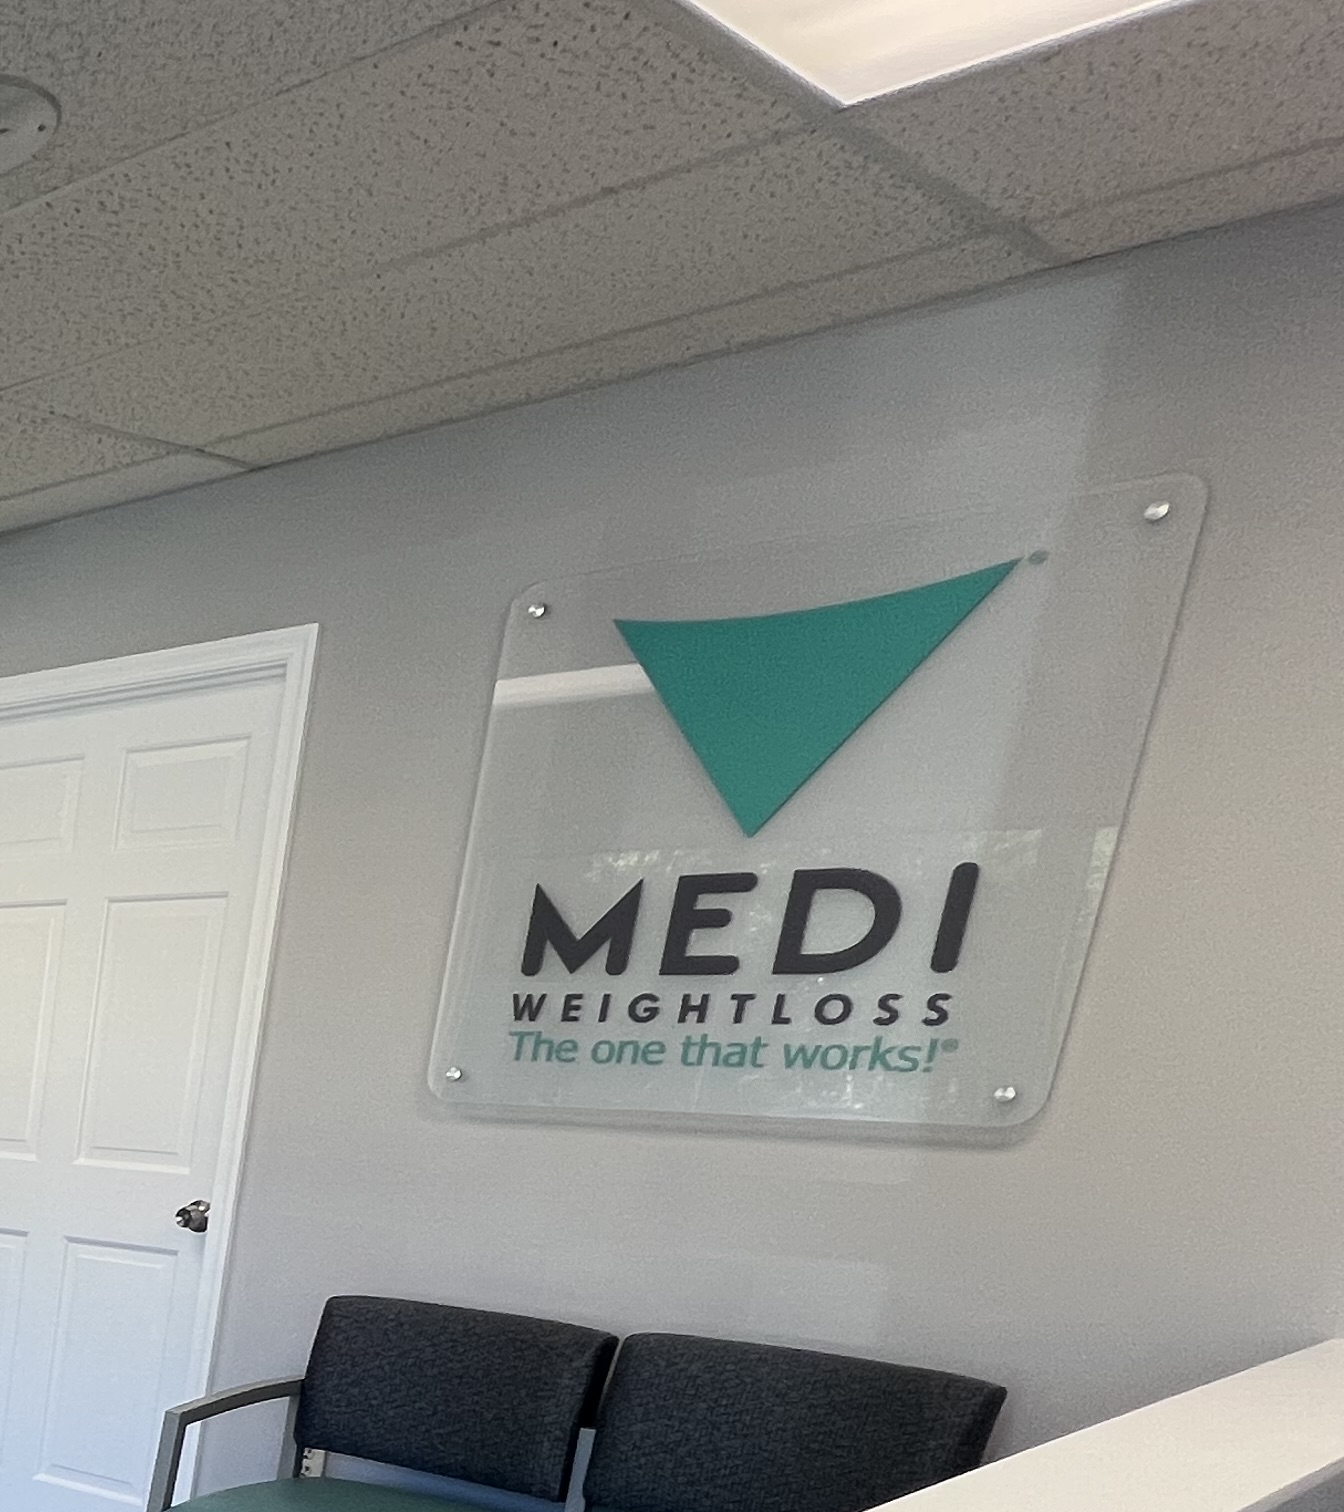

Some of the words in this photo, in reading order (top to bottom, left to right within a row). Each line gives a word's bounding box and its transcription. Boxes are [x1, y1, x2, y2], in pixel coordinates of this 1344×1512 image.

[521, 862, 979, 976] MEDI
[512, 993, 953, 1027] WEIGHTLOSS
[509, 1030, 578, 1064] The
[591, 1038, 666, 1066] one
[681, 1033, 769, 1069] that
